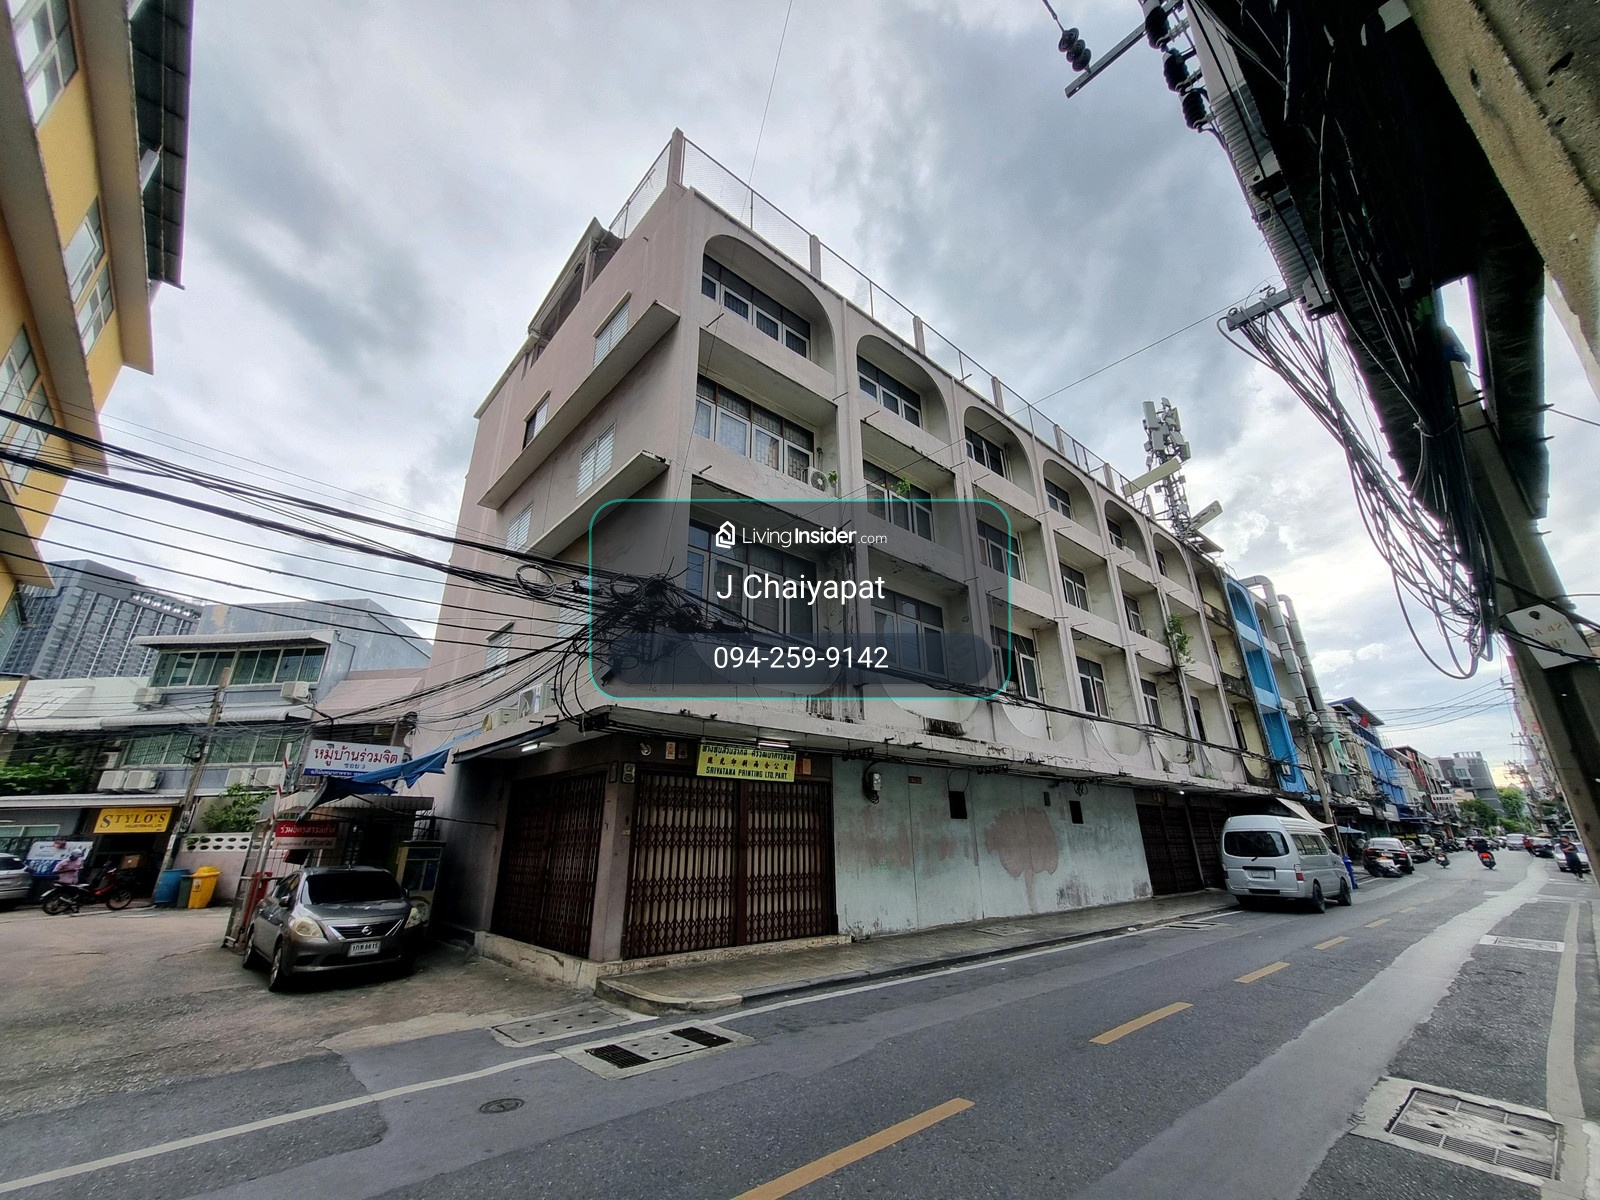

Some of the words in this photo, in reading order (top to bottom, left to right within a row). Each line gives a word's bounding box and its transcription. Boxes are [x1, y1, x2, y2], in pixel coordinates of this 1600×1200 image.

[314, 745, 399, 767] หมูบ้านร่วมจิต
[705, 766, 736, 776] SRIVATANA
[738, 769, 764, 778] PRINTING
[99, 813, 166, 829] STYLO'S
